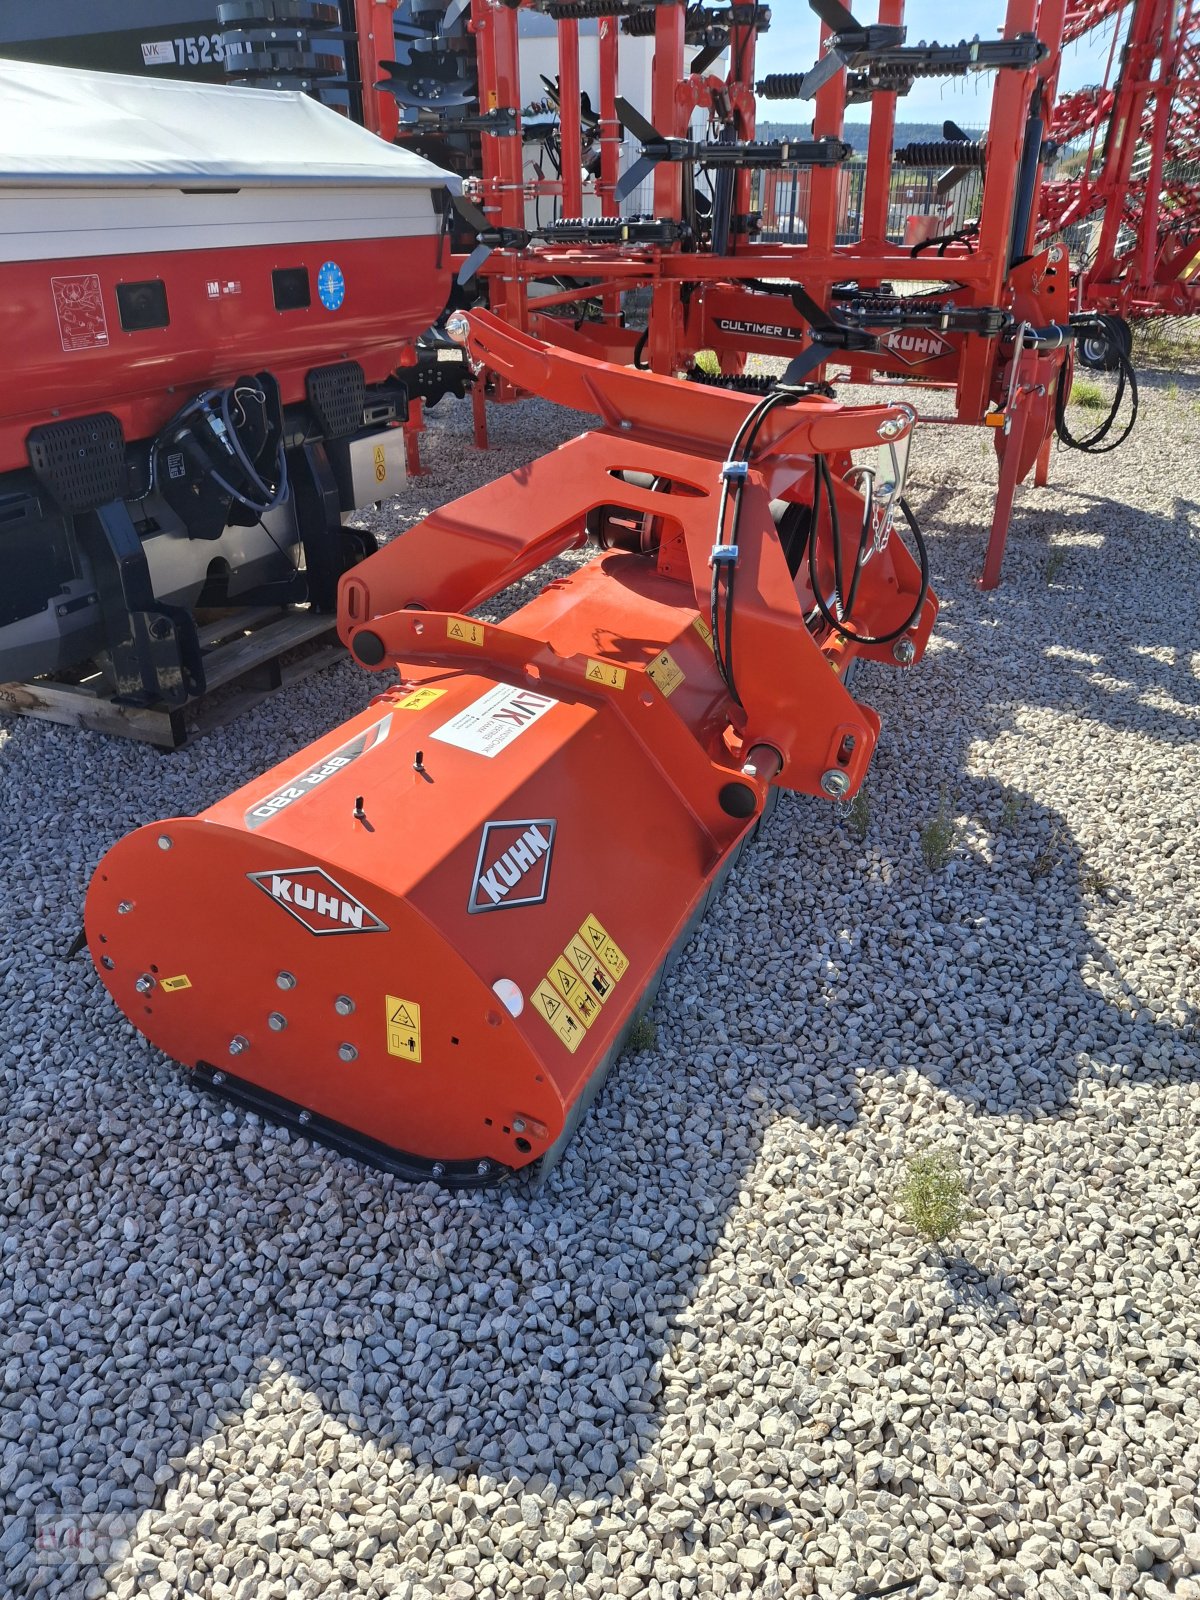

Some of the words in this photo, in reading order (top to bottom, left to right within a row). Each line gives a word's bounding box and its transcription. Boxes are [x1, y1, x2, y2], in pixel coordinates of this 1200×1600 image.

[142, 44, 160, 57] LVK
[720, 319, 783, 336] CULTIMER
[786, 327, 795, 338] L
[887, 333, 943, 355] KUHN
[492, 691, 552, 726] LVK
[300, 756, 351, 784] BPR
[252, 787, 305, 818] 280
[479, 824, 551, 905] KUHN
[272, 874, 363, 930] KUHN
